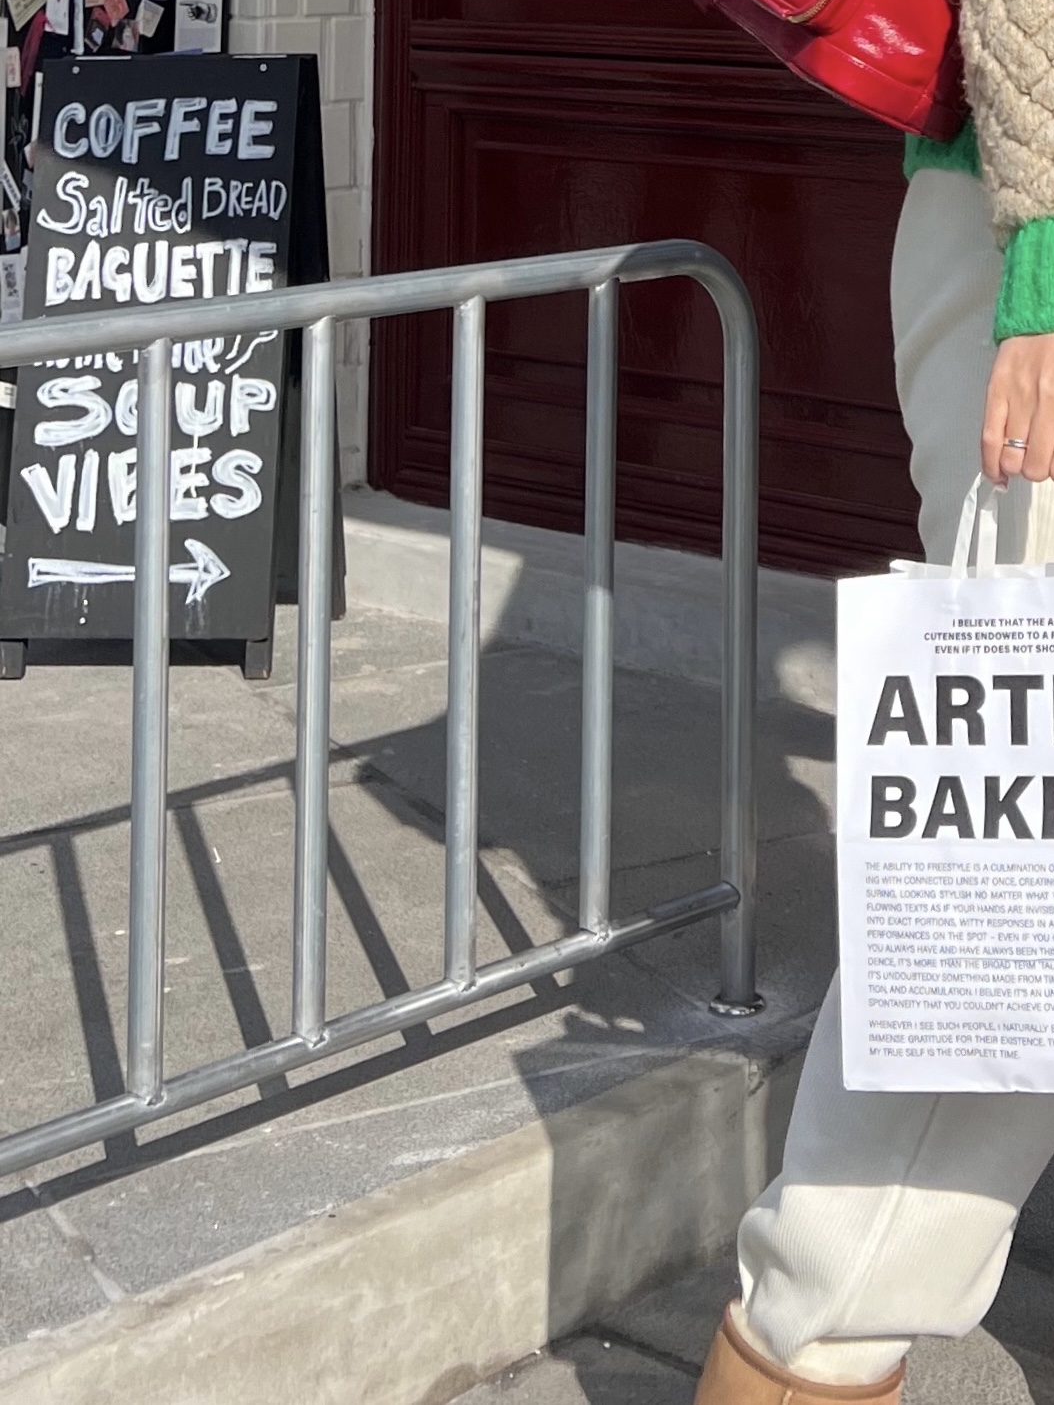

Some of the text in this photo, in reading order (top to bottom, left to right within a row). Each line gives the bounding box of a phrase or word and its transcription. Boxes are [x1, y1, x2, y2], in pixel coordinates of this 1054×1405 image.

[53, 97, 278, 164] COFFEE
[36, 171, 288, 238] Salted BREAD
[45, 238, 278, 307] BAGUETTE
[957, 618, 996, 628] BELIEVE
[999, 617, 1023, 628] THAT
[1026, 617, 1045, 627] THE
[923, 631, 972, 642] CUTENESS
[974, 631, 1024, 641] ENDOWED
[1027, 631, 1040, 641] TO
[934, 645, 960, 655] EVEN
[961, 645, 970, 655] IF
[972, 645, 980, 655] IT
[983, 644, 1010, 654] DOES
[1012, 644, 1032, 654] NOT
[865, 862, 880, 872] THE
[883, 862, 912, 872] ABILITY
[927, 862, 971, 872] FREESTYLE
[991, 863, 1046, 873] CULMINATION
[882, 876, 902, 885] WITH
[904, 877, 954, 886] CONNECTED
[956, 877, 979, 886] LINES
[900, 890, 936, 900] LOOKING
[940, 890, 972, 900] STYLISH
[991, 891, 1022, 901] MATTER
[1026, 891, 1049, 901] WHAT
[905, 903, 928, 913] TEXTS
[953, 903, 976, 914] YOUR
[977, 904, 1006, 914] HANDS
[1007, 904, 1023, 914] ARE
[867, 916, 885, 926] INTO
[887, 917, 912, 927] EXACT
[959, 917, 984, 928] WITTY
[987, 918, 1035, 928] RESPONSES
[867, 929, 930, 941] PERFORMANCES
[948, 930, 964, 941] THE
[967, 931, 987, 942] SPOT
[998, 931, 1020, 942] EVEN
[1032, 932, 1050, 942] YOU
[867, 944, 884, 954] YOU
[885, 944, 915, 954] ALWAYS
[917, 944, 938, 955] HAVE
[939, 944, 957, 955] AND
[959, 945, 980, 955] HAVE
[983, 945, 1014, 956] ALWAYS
[914, 957, 937, 968] MORE
[940, 958, 962, 968] THAN
[964, 958, 980, 969] THE
[982, 958, 1012, 969] BROAD
[942, 971, 990, 983] SOMETHING
[992, 972, 1016, 983] MADE
[1018, 972, 1042, 983] FROM
[979, 986, 1012, 997] BELIEVE
[923, 999, 942, 1009] THAT
[943, 999, 962, 1010] YOU
[1007, 1000, 1042, 1011] ACHIEVE
[919, 1020, 934, 1030] SEE
[937, 1021, 960, 1031] SUCH
[908, 1034, 953, 1045] GRATITUDE
[976, 1035, 998, 1045] THEIR
[883, 1047, 997, 1059] TRUE SELF COMPLETE
